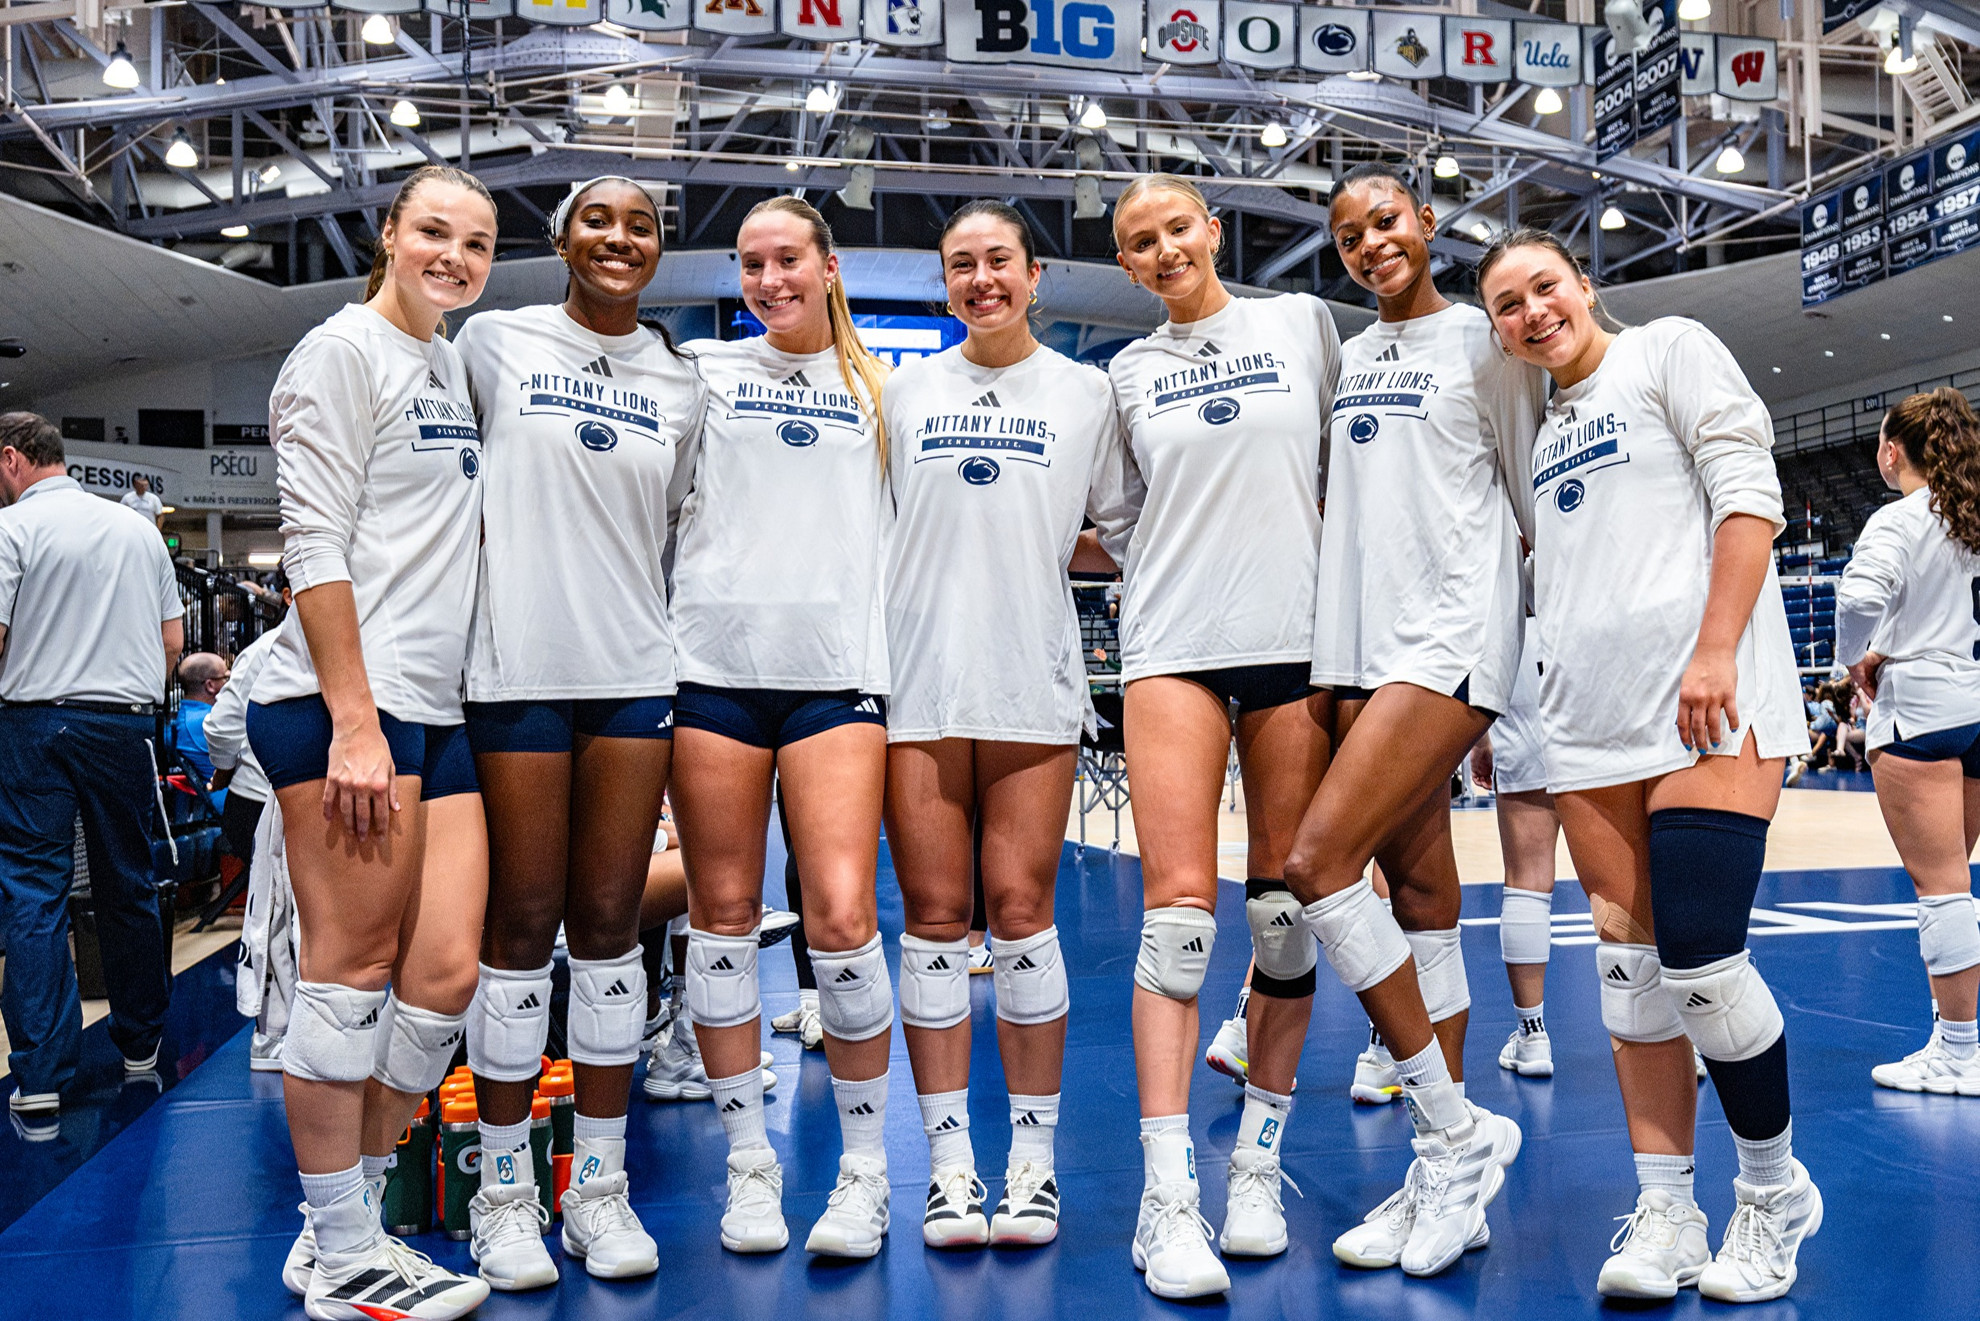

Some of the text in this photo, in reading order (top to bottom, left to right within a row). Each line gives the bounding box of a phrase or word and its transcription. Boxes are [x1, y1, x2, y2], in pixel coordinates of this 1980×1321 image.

[1238, 16, 1280, 53] O
[1461, 29, 1498, 67] R
[1637, 52, 1678, 92] 2007
[1732, 51, 1765, 88] W
[1594, 81, 1633, 119] 2004
[1934, 185, 1980, 217] 1957
[1889, 206, 1930, 236] 1954
[1844, 226, 1881, 253] 1953
[1803, 243, 1839, 270] 1948
[531, 373, 605, 401] NITTANY
[1154, 361, 1218, 394] NITTANY
[1337, 372, 1386, 397] NITTANY
[552, 397, 586, 410] PENN
[737, 382, 807, 404] NITTANY
[1173, 388, 1204, 400] PENN
[1340, 397, 1362, 406] PENN
[413, 397, 460, 421] NITTANY
[755, 402, 788, 412] PENN
[436, 427, 458, 436] PENN
[924, 415, 993, 435] NITTANY
[939, 438, 970, 446] PENN
[1538, 467, 1559, 483] PENN
